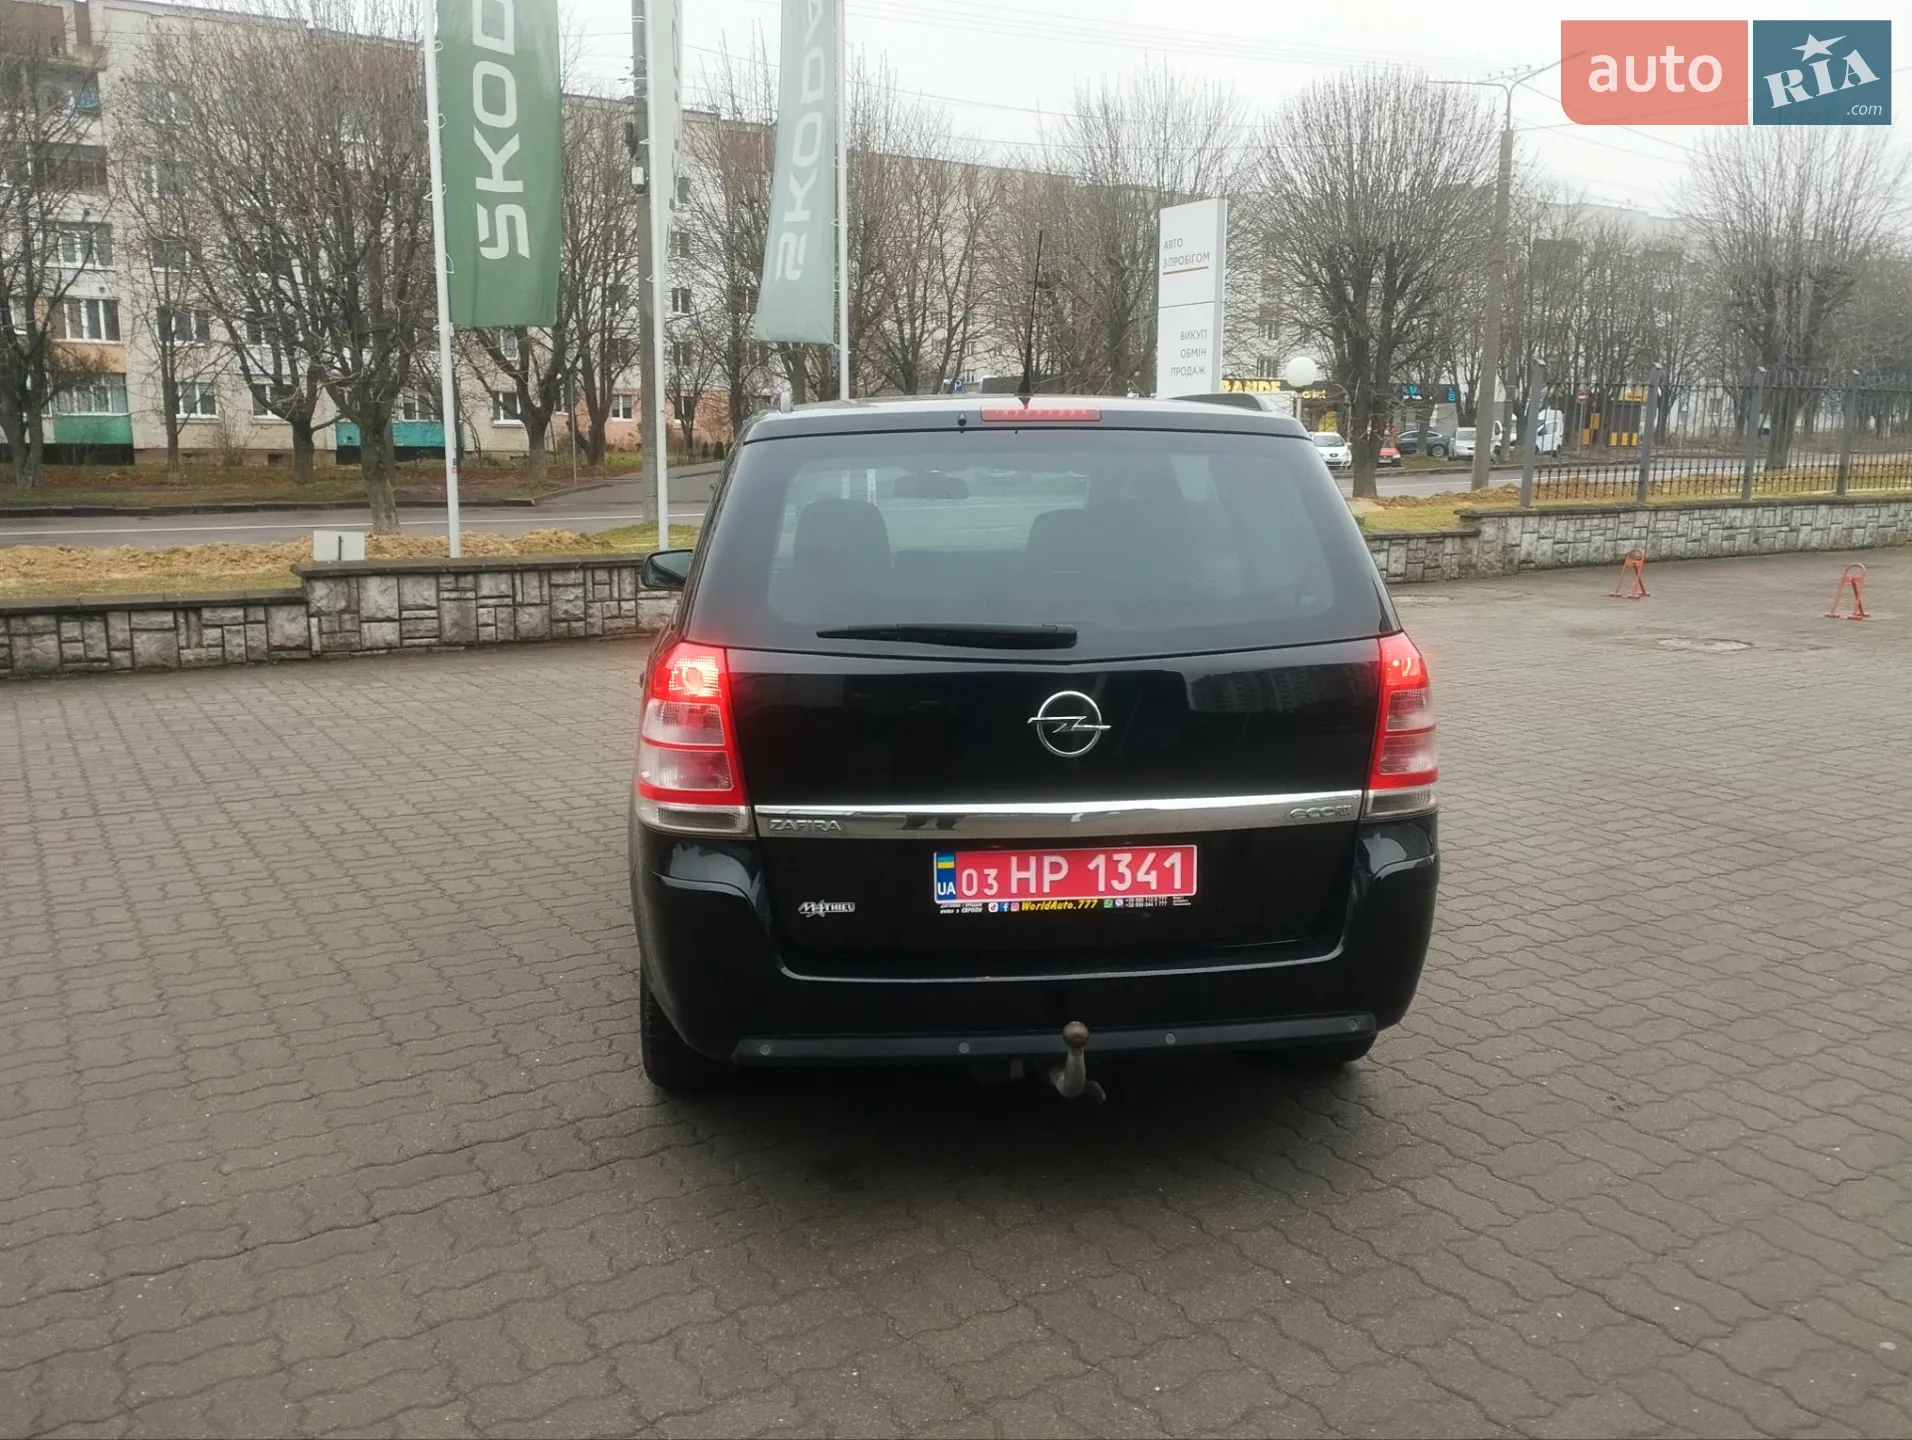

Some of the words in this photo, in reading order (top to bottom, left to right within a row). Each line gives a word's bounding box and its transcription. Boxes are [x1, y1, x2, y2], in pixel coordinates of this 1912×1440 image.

[1163, 237, 1184, 250] АВТО
[1168, 251, 1210, 268] ПРОБІГОМ
[1180, 329, 1208, 341] ВИКУП
[1180, 347, 1207, 359] ОБМІН
[1170, 365, 1206, 377] ПРОДАЖ
[770, 819, 843, 832] ZAFIRA
[961, 868, 999, 897] 03
[1010, 855, 1069, 894] HP
[1087, 851, 1182, 892] 1341
[937, 882, 957, 896] UA
[1021, 899, 1099, 911] WorldAuto.777
